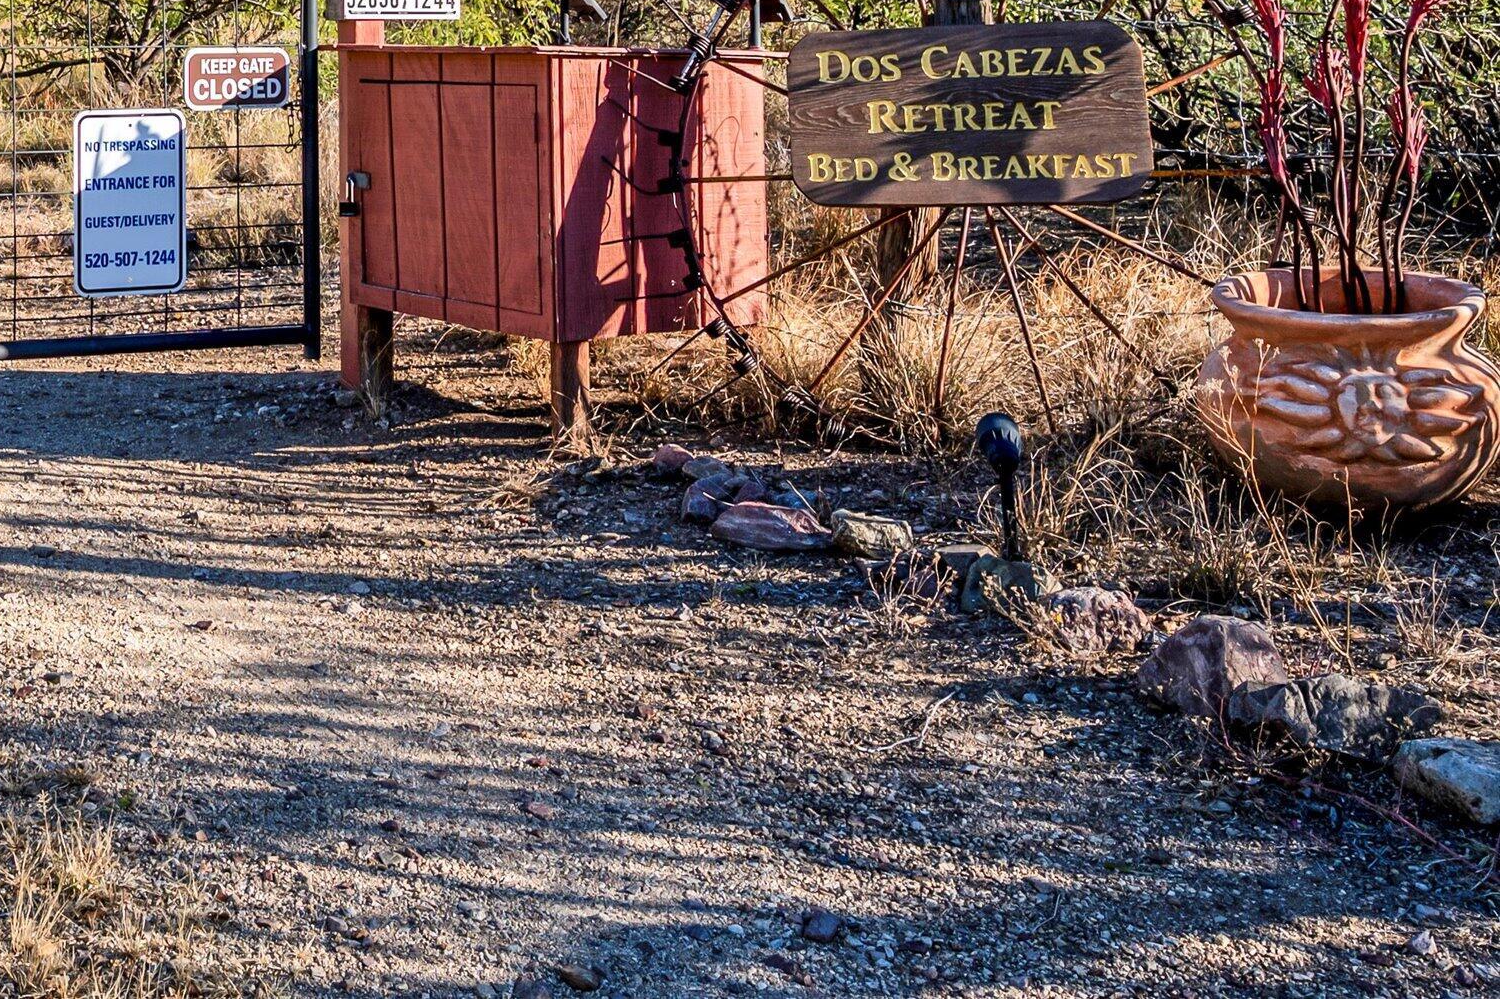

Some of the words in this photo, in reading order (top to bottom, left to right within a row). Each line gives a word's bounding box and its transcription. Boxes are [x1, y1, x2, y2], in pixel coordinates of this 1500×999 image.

[201, 58, 237, 74] KEEP
[239, 57, 275, 73] GATE
[193, 78, 282, 100] CLOSED
[85, 142, 100, 152] NO
[102, 139, 175, 152] TRESPASSING
[888, 152, 922, 182] &
[85, 177, 149, 191] ENTRANCE
[153, 175, 175, 188] FOR
[85, 213, 175, 229] GUEST/DELIVERY
[85, 250, 175, 268] 520-507-1244
